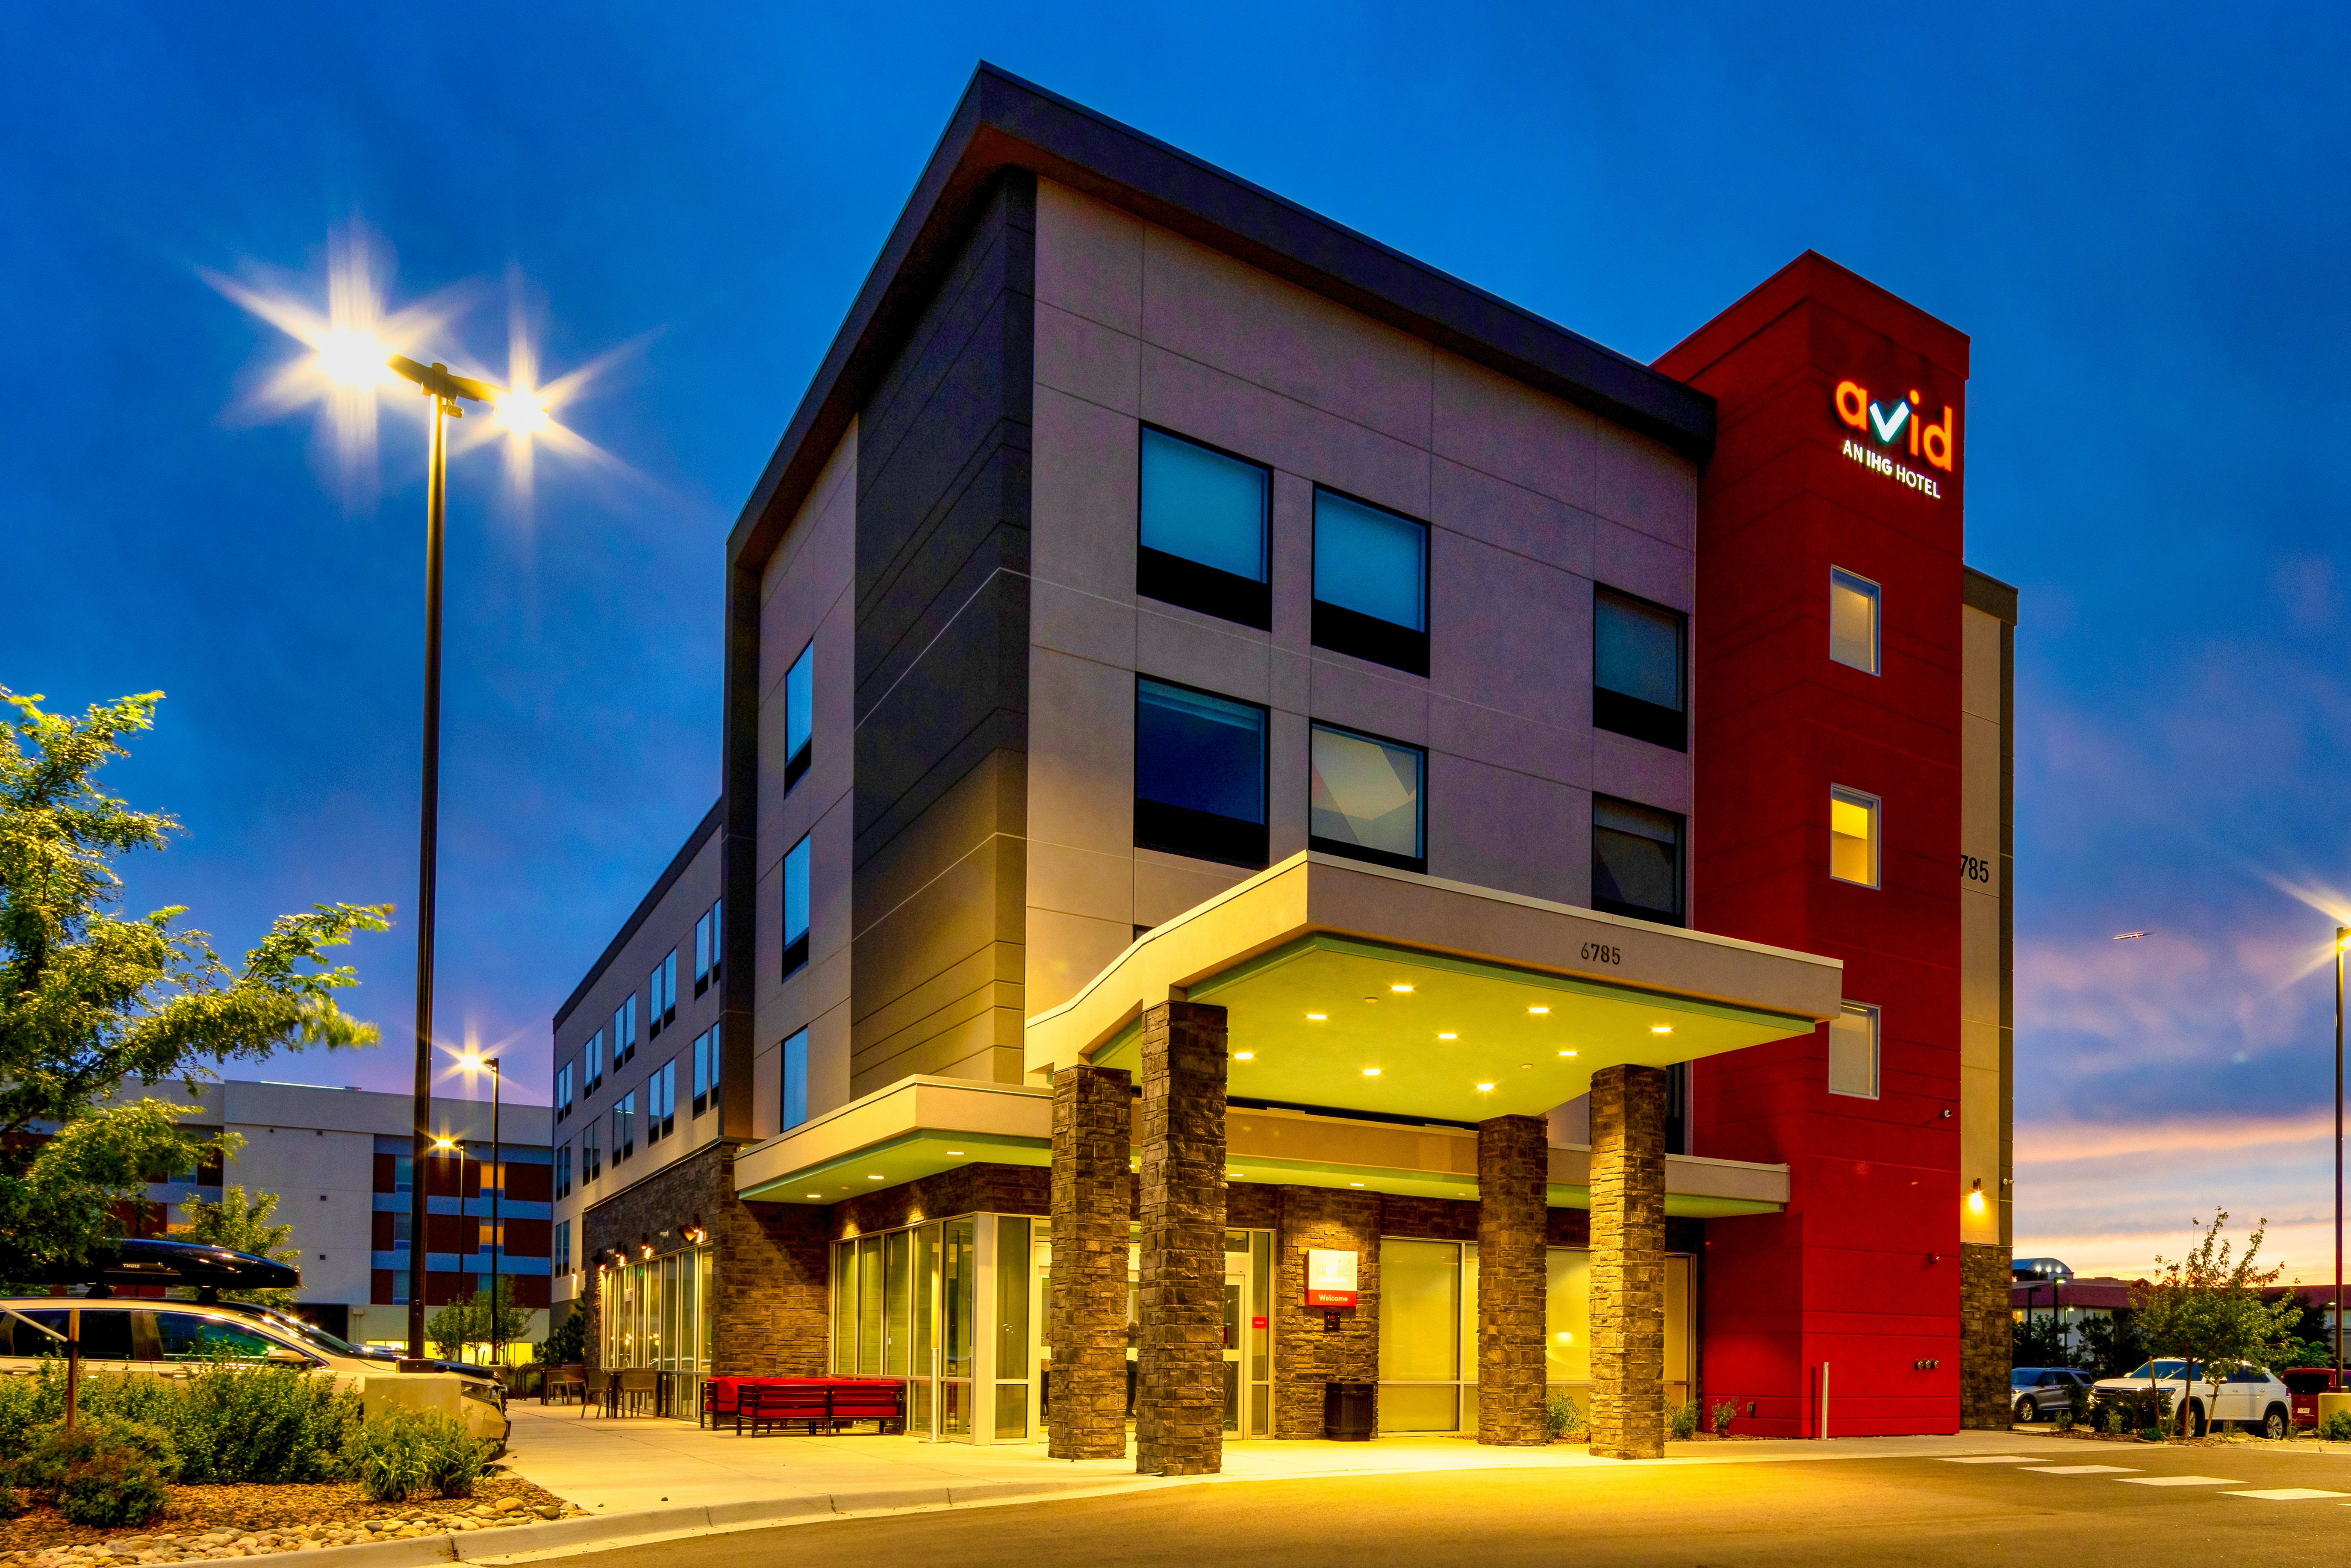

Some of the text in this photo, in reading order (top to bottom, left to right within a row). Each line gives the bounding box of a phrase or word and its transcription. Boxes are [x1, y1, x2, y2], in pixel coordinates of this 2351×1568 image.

[1835, 380, 1952, 472] avid
[1842, 439, 1941, 499] AN IHG HOTEL
[1581, 942, 1620, 965] 6785
